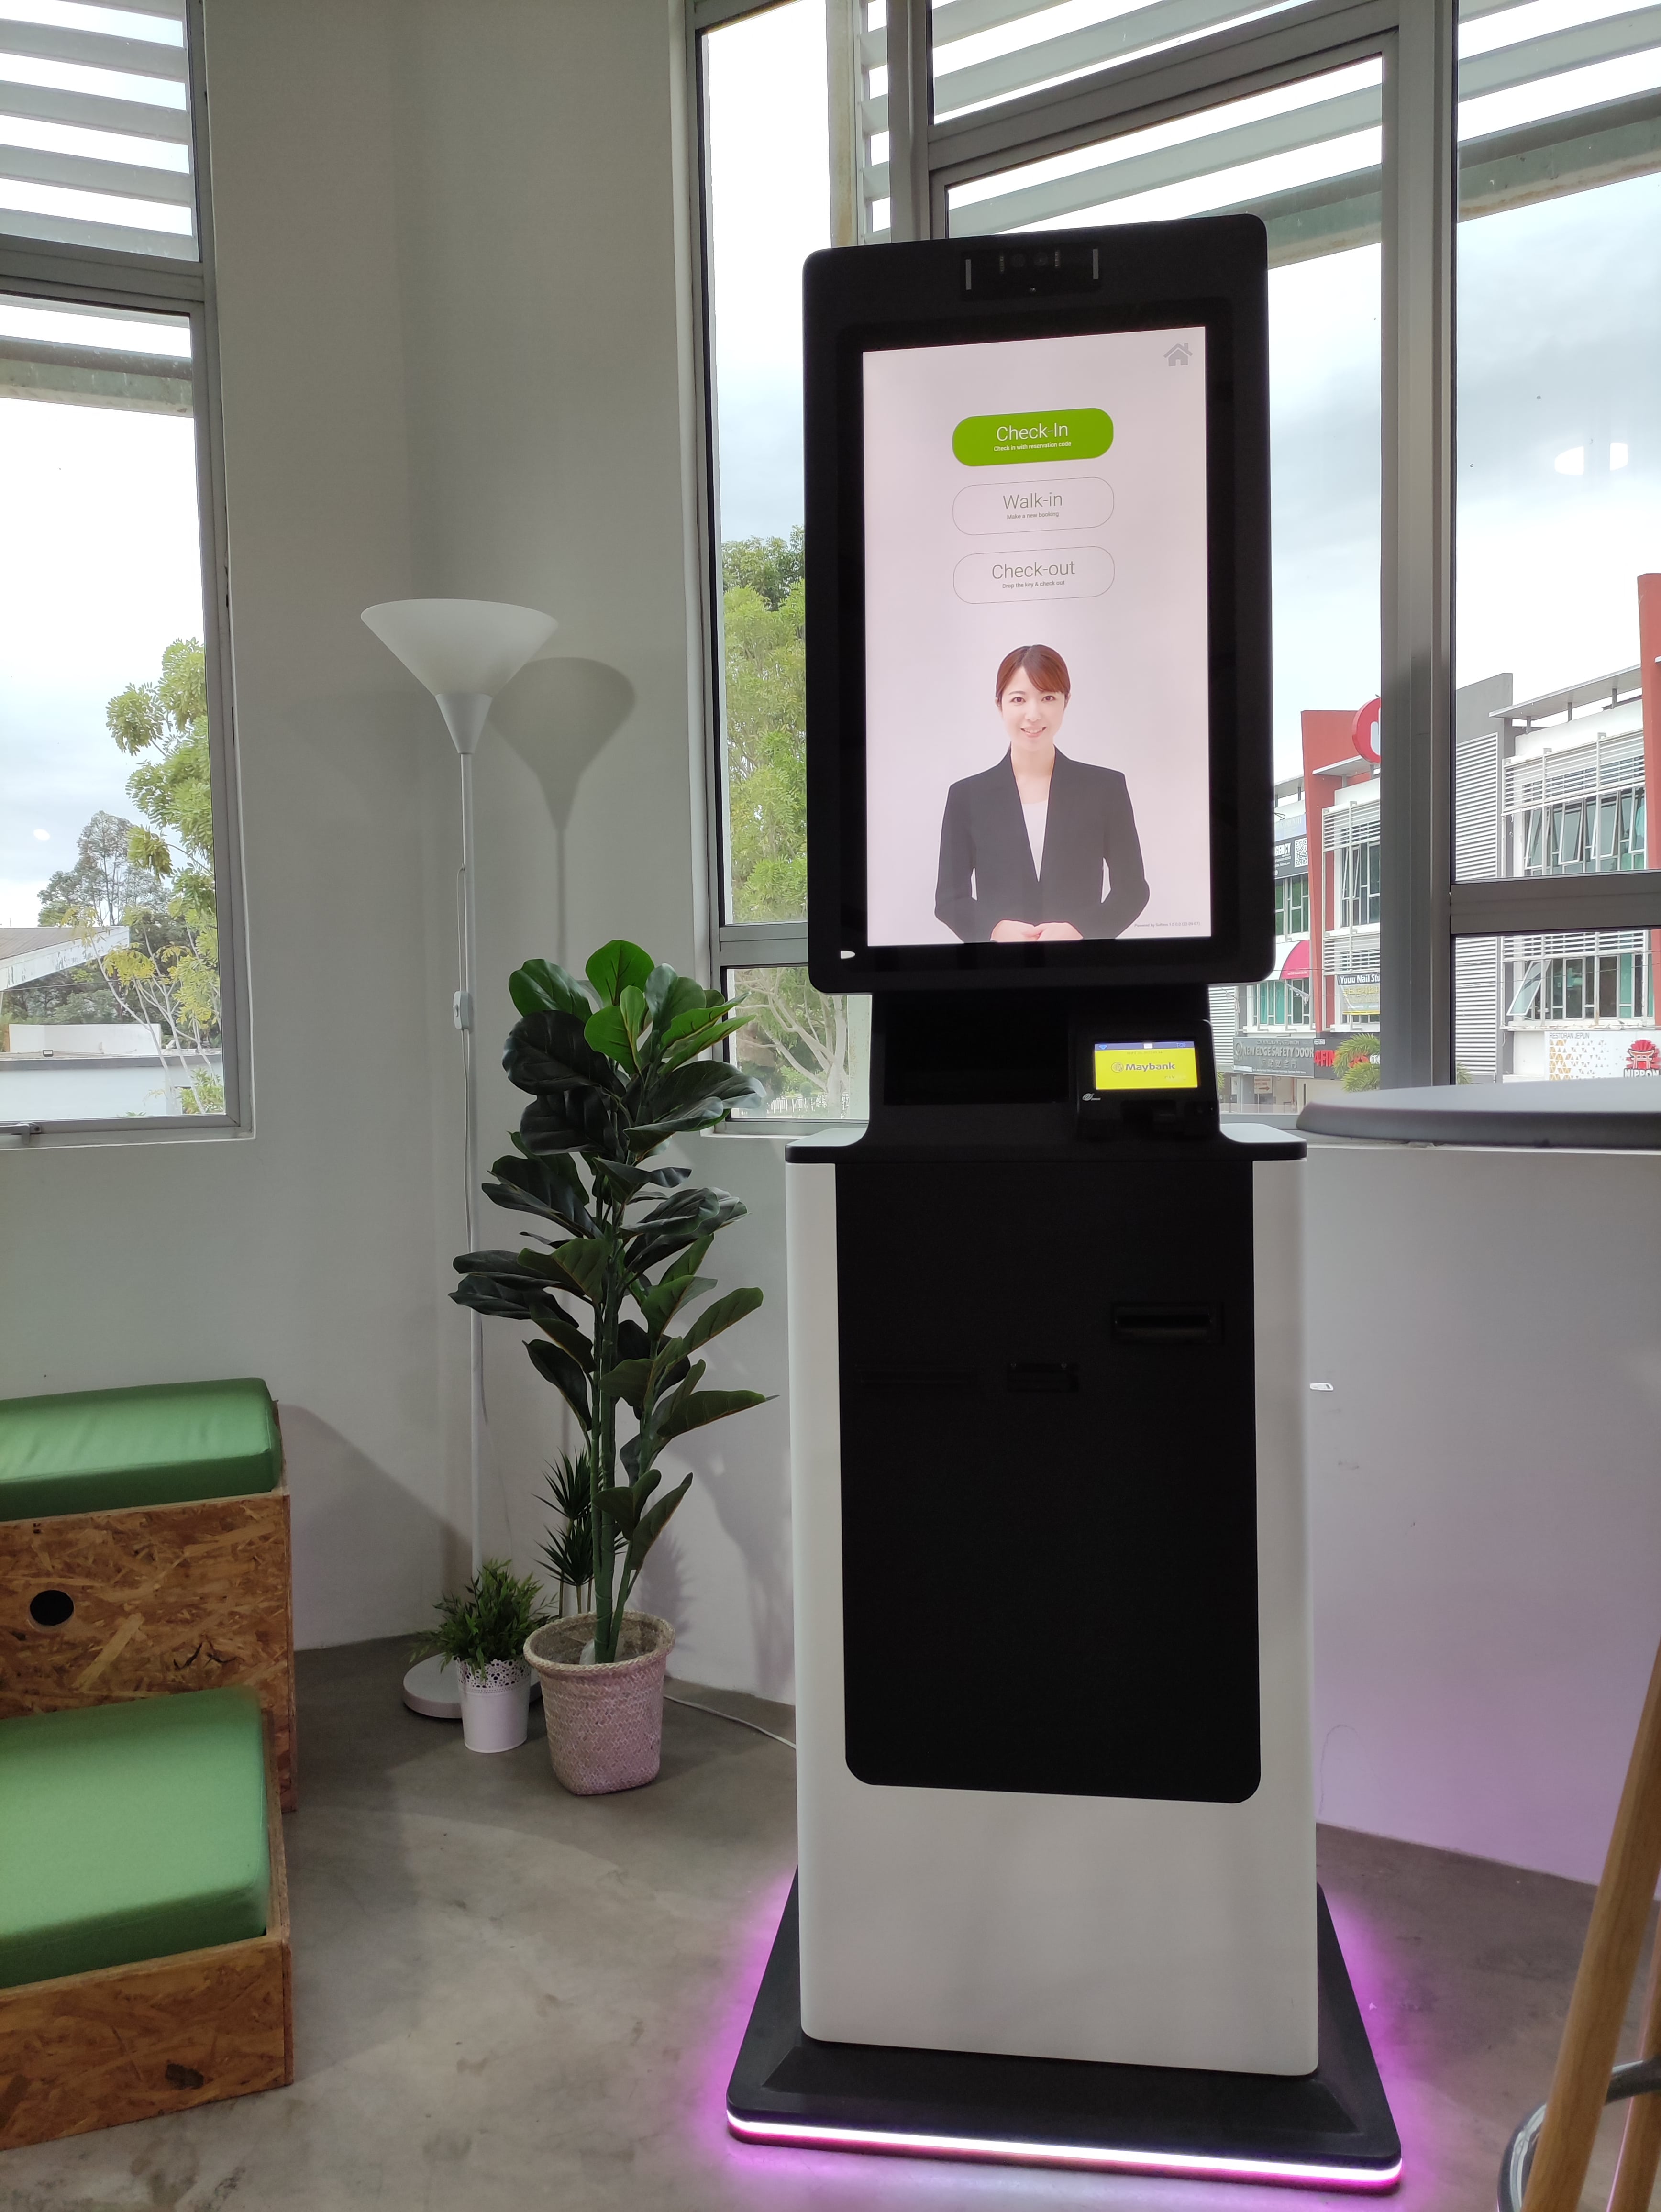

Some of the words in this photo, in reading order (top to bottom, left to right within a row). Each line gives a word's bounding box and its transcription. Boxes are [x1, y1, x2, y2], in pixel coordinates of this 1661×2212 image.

[997, 422, 1068, 441] Check-In
[1003, 492, 1062, 509] Walk-in
[992, 561, 1075, 579] Check-out
[1340, 975, 1356, 984] Yuuu
[1357, 974, 1370, 983] Nail
[1243, 1046, 1255, 1056] NEW
[1256, 1046, 1271, 1056] EDGE
[1272, 1046, 1294, 1057] SAFETY
[1295, 1047, 1314, 1058] DOOR
[1126, 1062, 1175, 1072] Maybank
[1624, 1068, 1659, 1078] NIPPON
